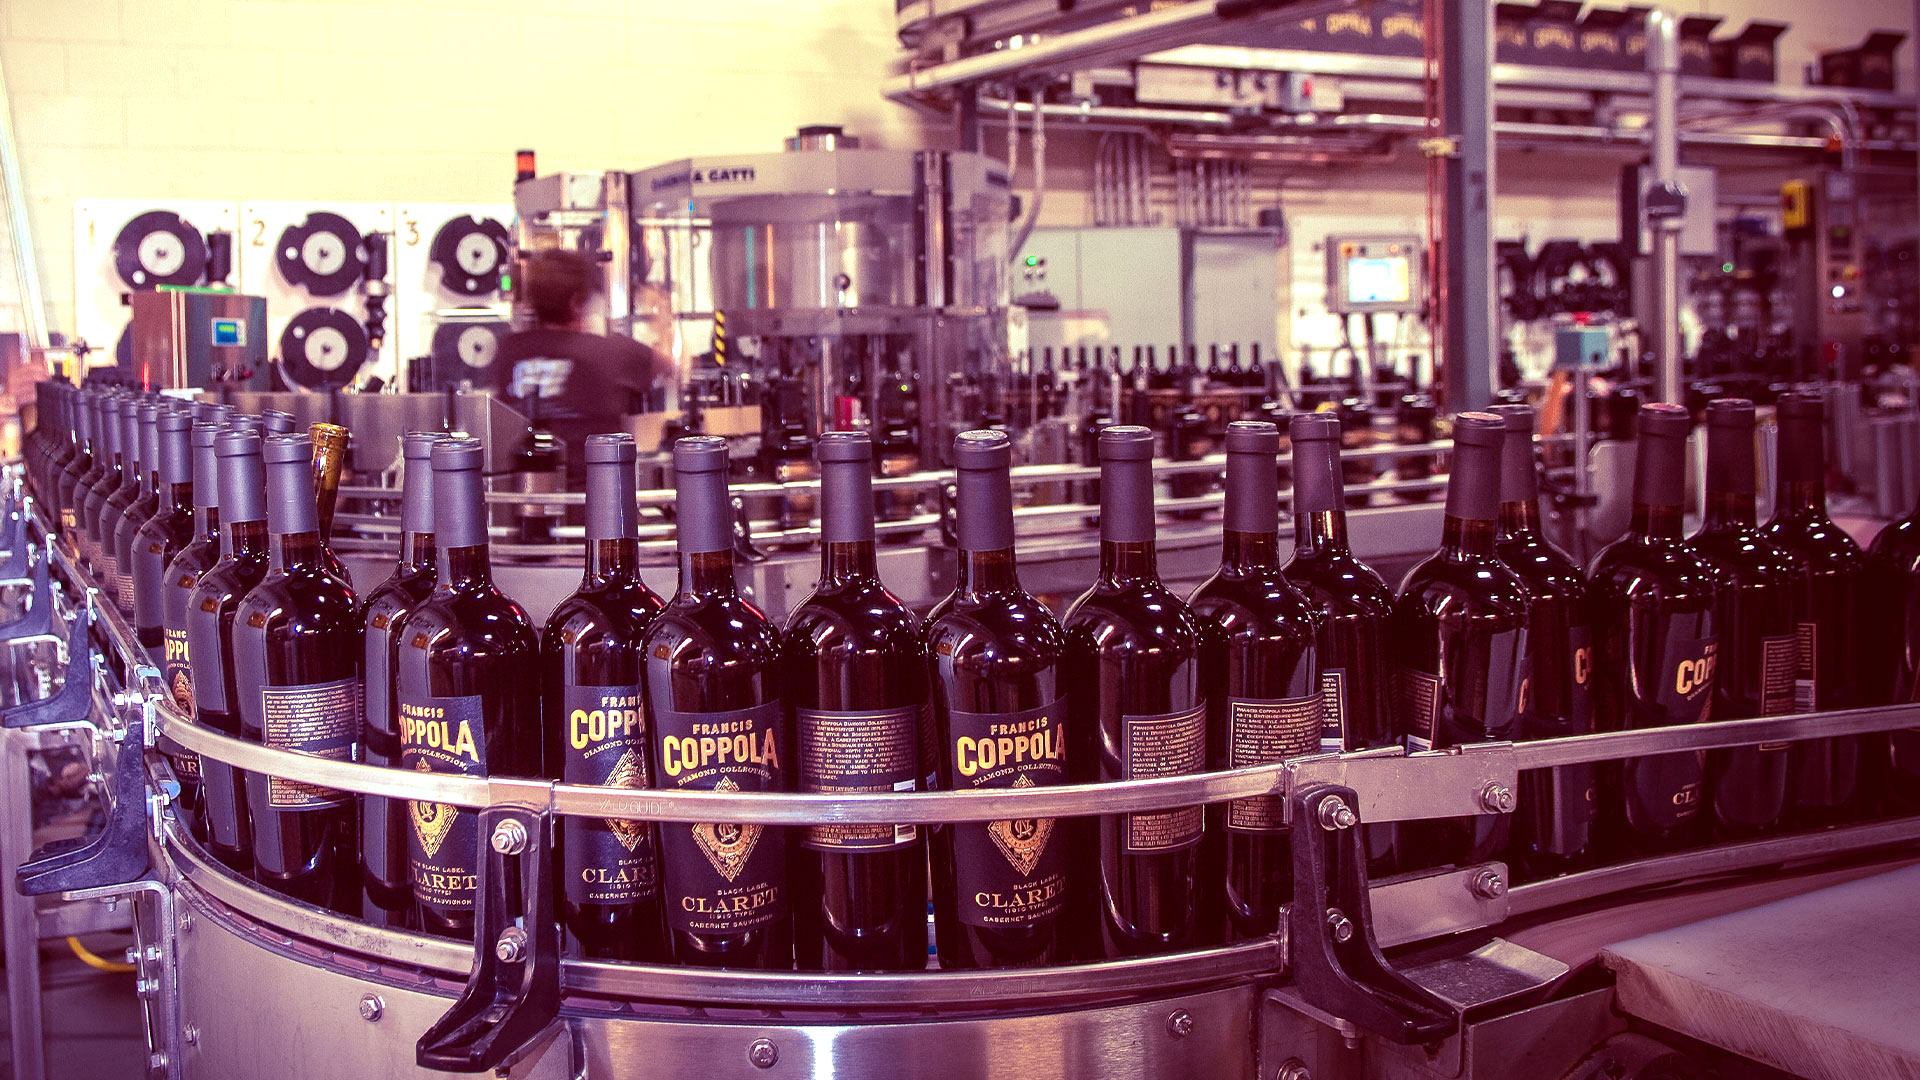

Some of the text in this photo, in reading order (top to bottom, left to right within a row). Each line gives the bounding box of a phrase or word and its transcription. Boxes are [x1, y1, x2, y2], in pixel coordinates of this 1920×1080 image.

[709, 167, 754, 183] GATTI
[252, 220, 266, 246] 2
[405, 221, 420, 246] 3
[402, 703, 444, 719] FRANCIS
[692, 719, 753, 735] FRANCIS
[990, 716, 1048, 736] FRANCIS
[583, 740, 623, 759] DIAMOND
[664, 728, 779, 777] COPPOLA
[957, 723, 1066, 777] COPPOLA
[678, 768, 717, 787] DIAMOND
[972, 768, 1014, 786] DIAMOND
[976, 876, 1066, 908] CLARET
[1014, 881, 1038, 890] BLACK
[682, 887, 778, 913] CLARET
